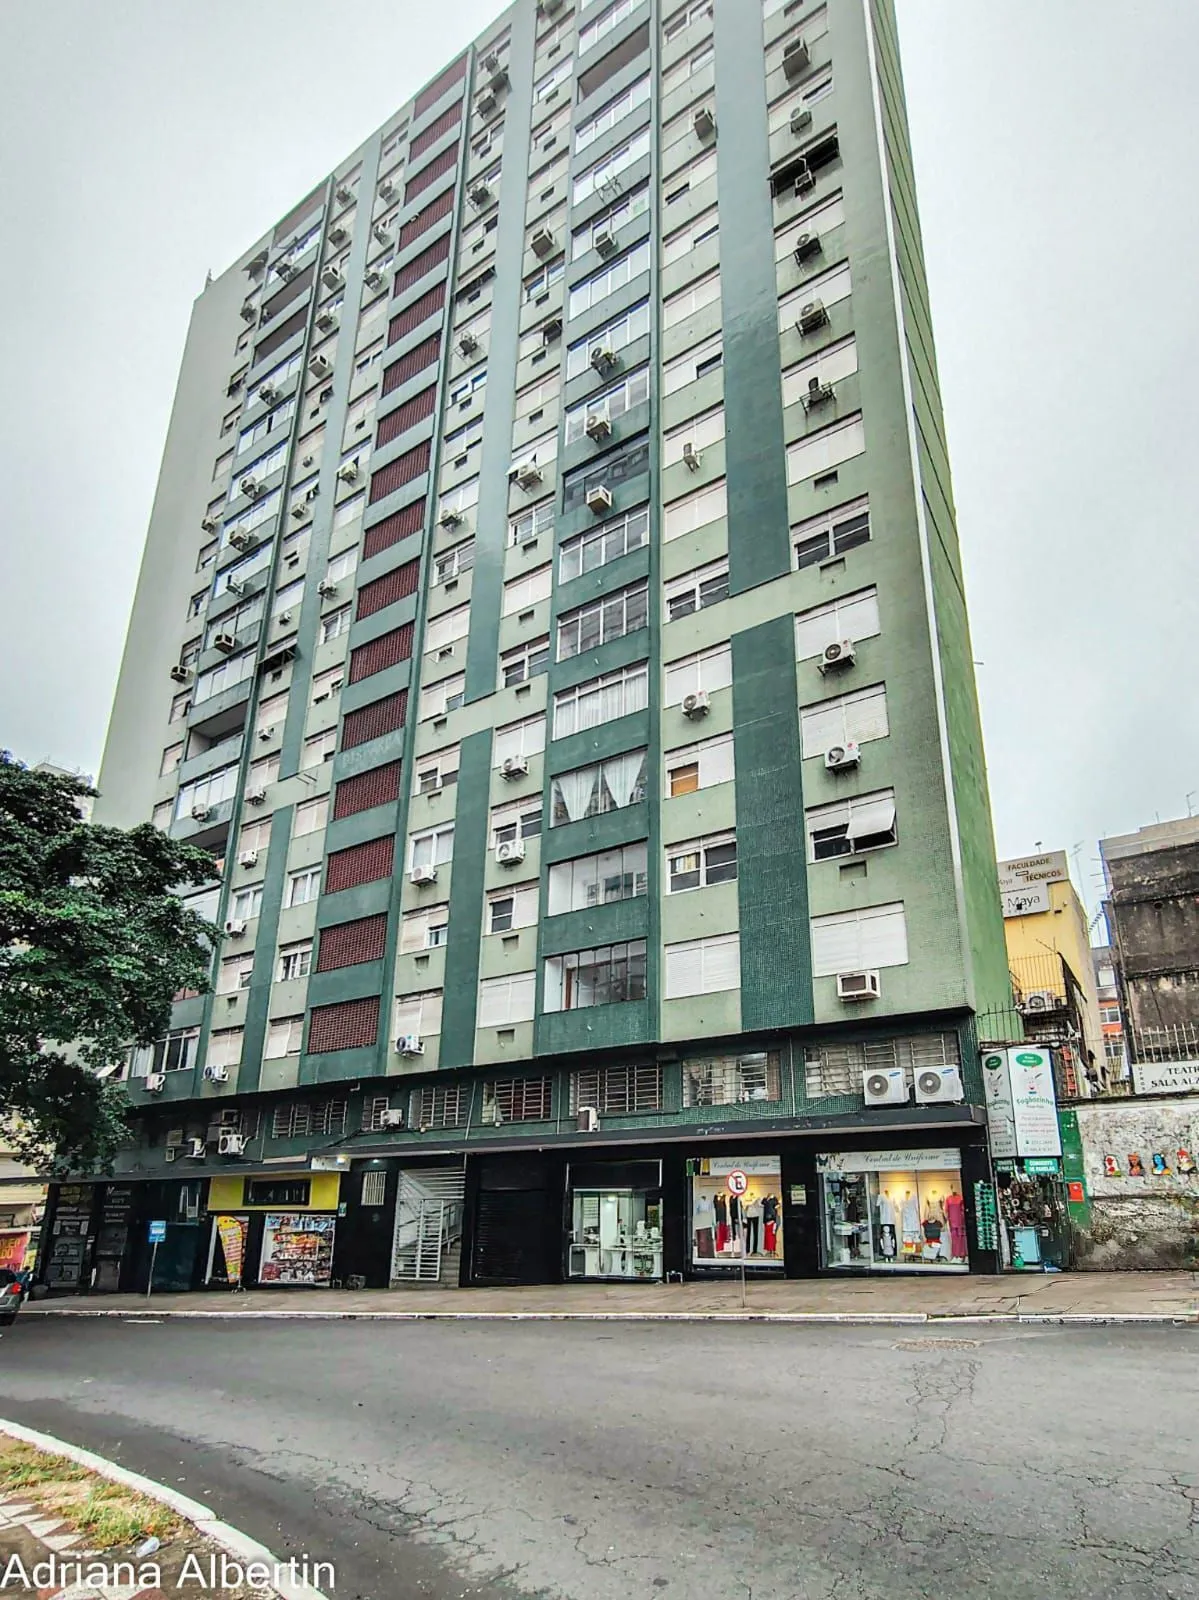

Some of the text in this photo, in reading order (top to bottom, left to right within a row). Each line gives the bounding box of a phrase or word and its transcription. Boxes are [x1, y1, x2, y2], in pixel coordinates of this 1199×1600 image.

[1008, 858, 1050, 871] FACULDADE
[1007, 895, 1041, 908] Maya
[1151, 1079, 1178, 1088] SALA
